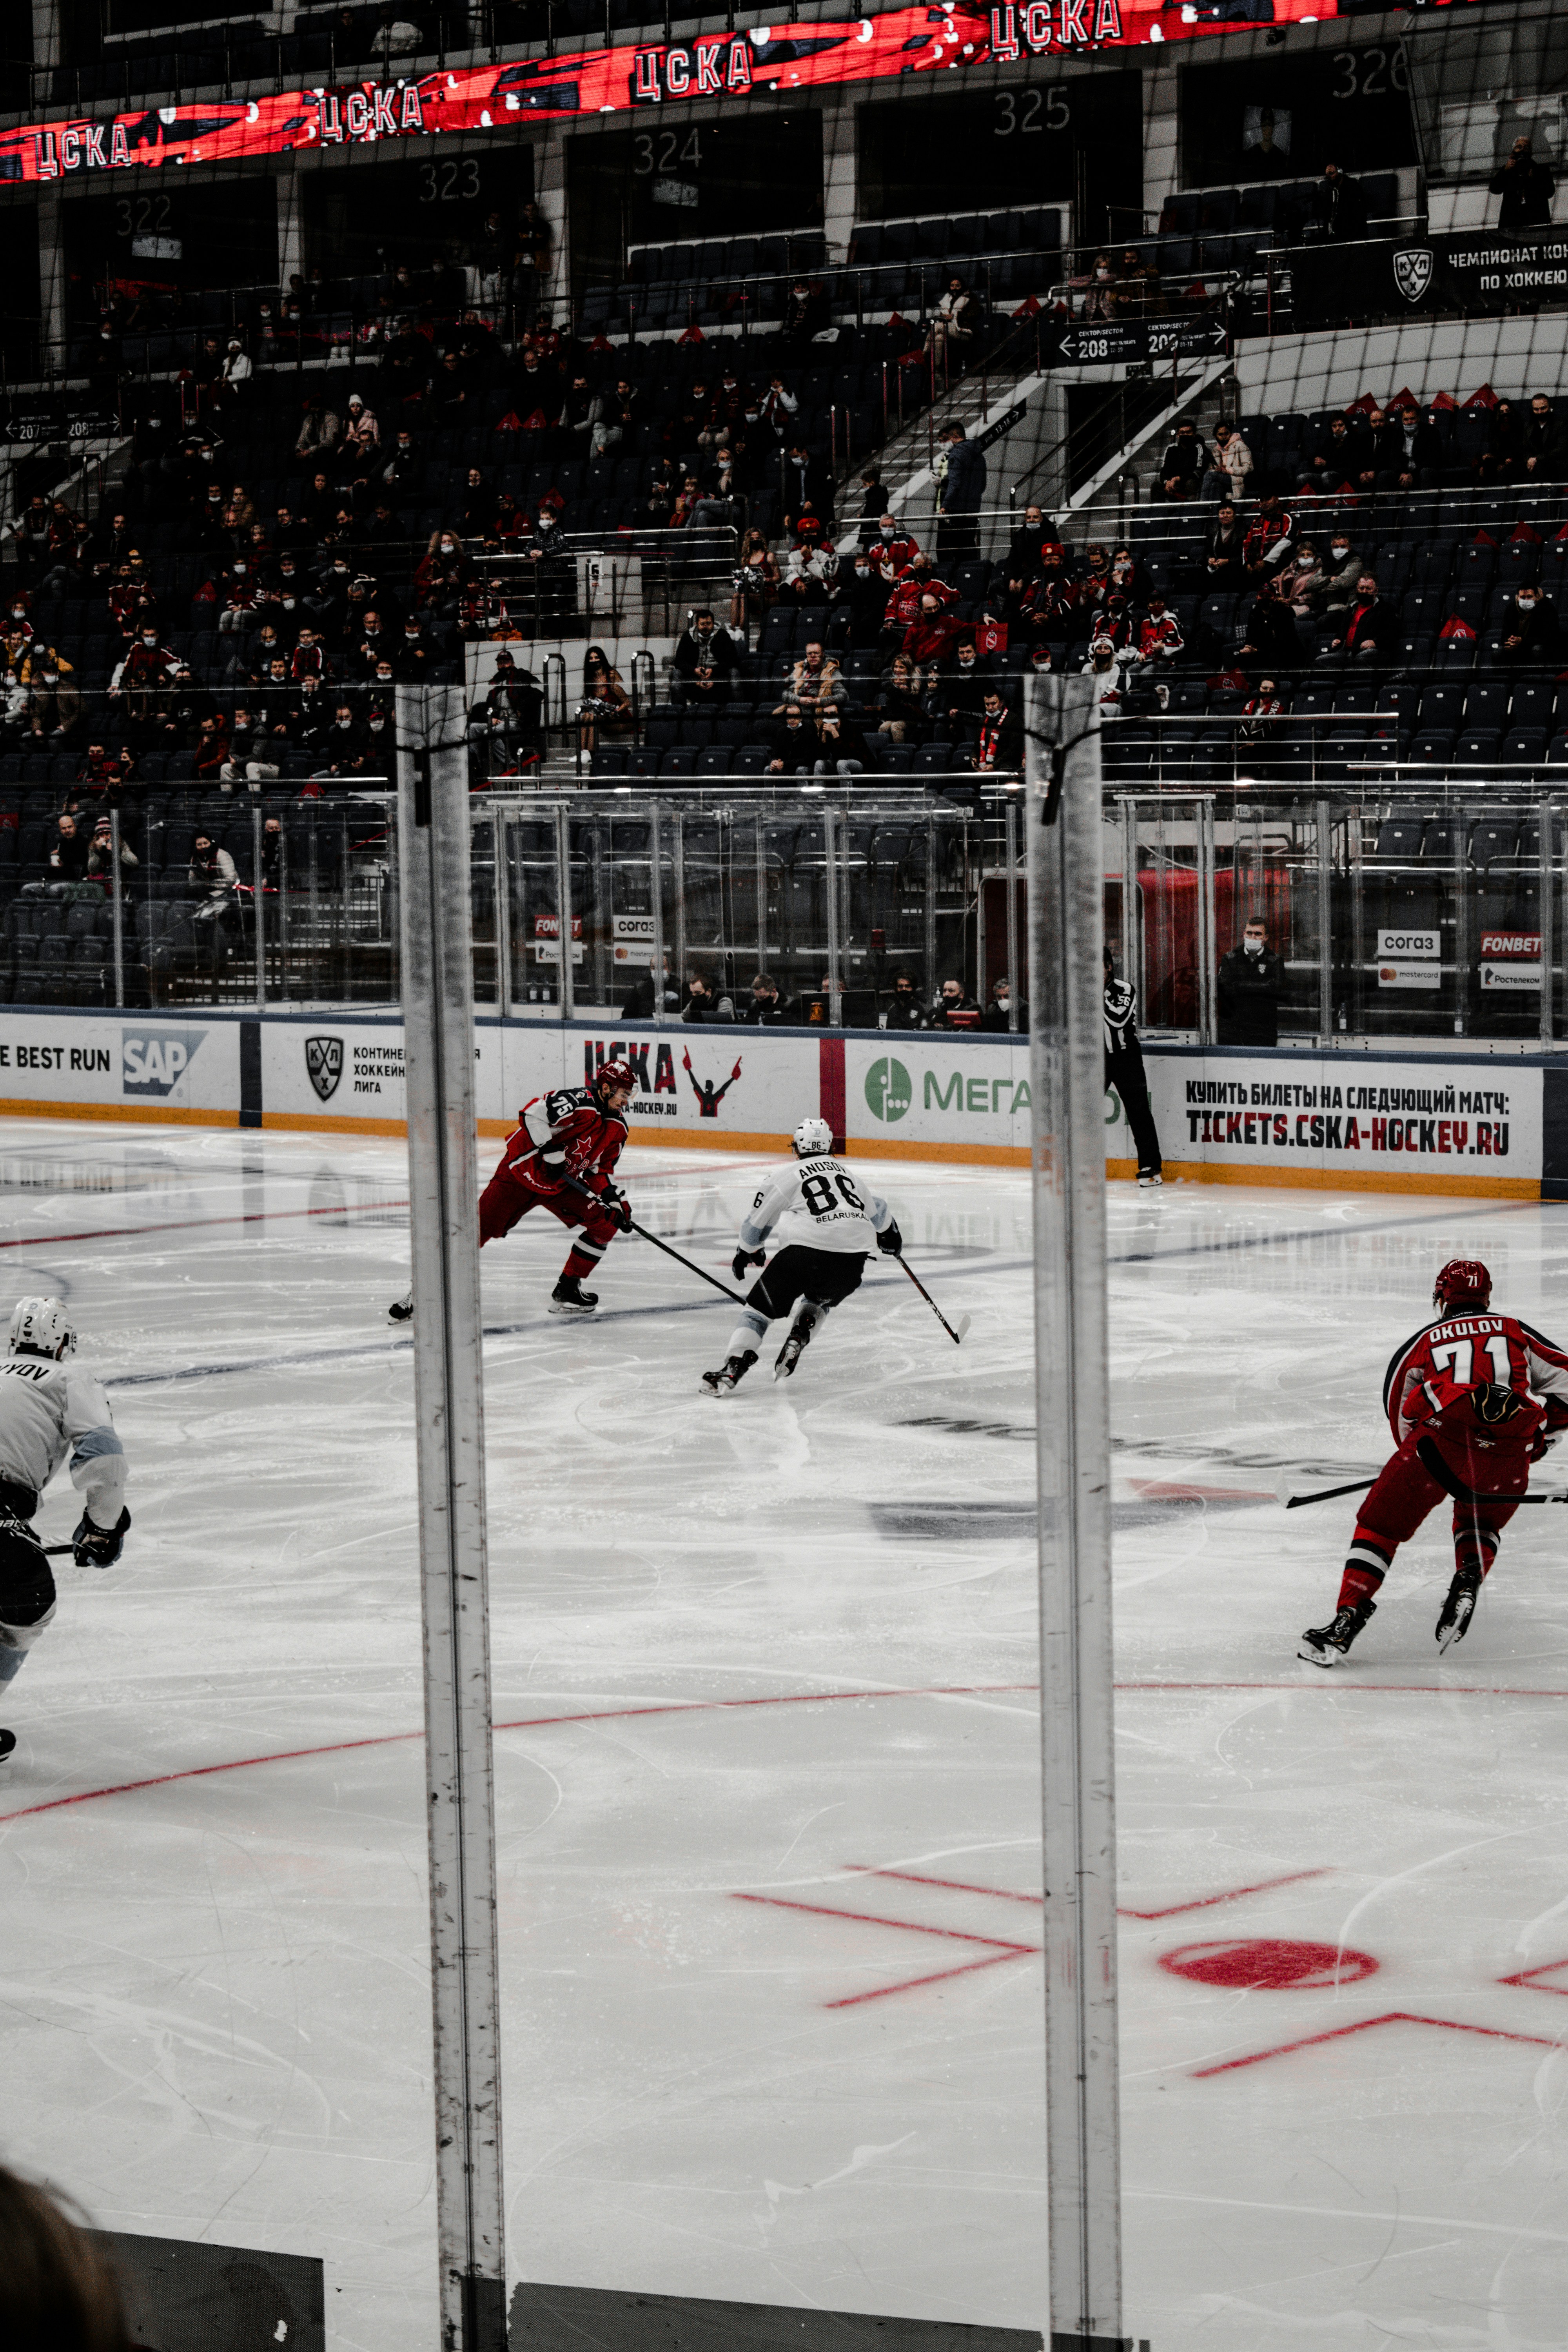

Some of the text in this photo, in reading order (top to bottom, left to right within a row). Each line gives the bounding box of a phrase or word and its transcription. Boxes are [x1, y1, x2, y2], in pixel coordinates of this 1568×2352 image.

[991, 0, 1121, 58] ЦСКА
[635, 41, 751, 102] ЦСКА
[319, 85, 423, 143] ЦСКА
[993, 85, 1071, 136] 325
[35, 123, 131, 177] ЦСКА
[634, 127, 703, 176] 324
[418, 158, 481, 203] 323
[116, 194, 172, 236] 322
[1449, 247, 1538, 268] ЧЕМПИОНАТ
[1480, 269, 1568, 290] ПО ХОККЕЮ
[1148, 321, 1192, 331] СЕКТОР/SECT
[1078, 339, 1108, 359] 208
[535, 920, 581, 932] FONT
[1482, 937, 1544, 952] FONBET
[1495, 975, 1540, 984] Ростелеком
[1117, 996, 1131, 1007] 56
[17, 1046, 64, 1069] BEST
[71, 1048, 110, 1072] RUN
[123, 1039, 187, 1085] SAP
[354, 1063, 405, 1078] ХОККЕЙН
[354, 1081, 381, 1094] ЛИГА
[1186, 1080, 1510, 1115] КУПИТЬ БИЛЕТЫ НА СЛЕДУЮЩИЙ МАТЧ:
[552, 1096, 573, 1116] 75
[1186, 1109, 1509, 1156] TICKETS.CSKA-HOCKEY.RU
[811, 1141, 821, 1149] 86
[753, 1192, 764, 1209] 6
[801, 1173, 865, 1216] 86
[1468, 1275, 1478, 1287] 71
[24, 1316, 33, 1328] 2
[1429, 1319, 1503, 1343] OKULOV
[1430, 1335, 1512, 1390] 71
